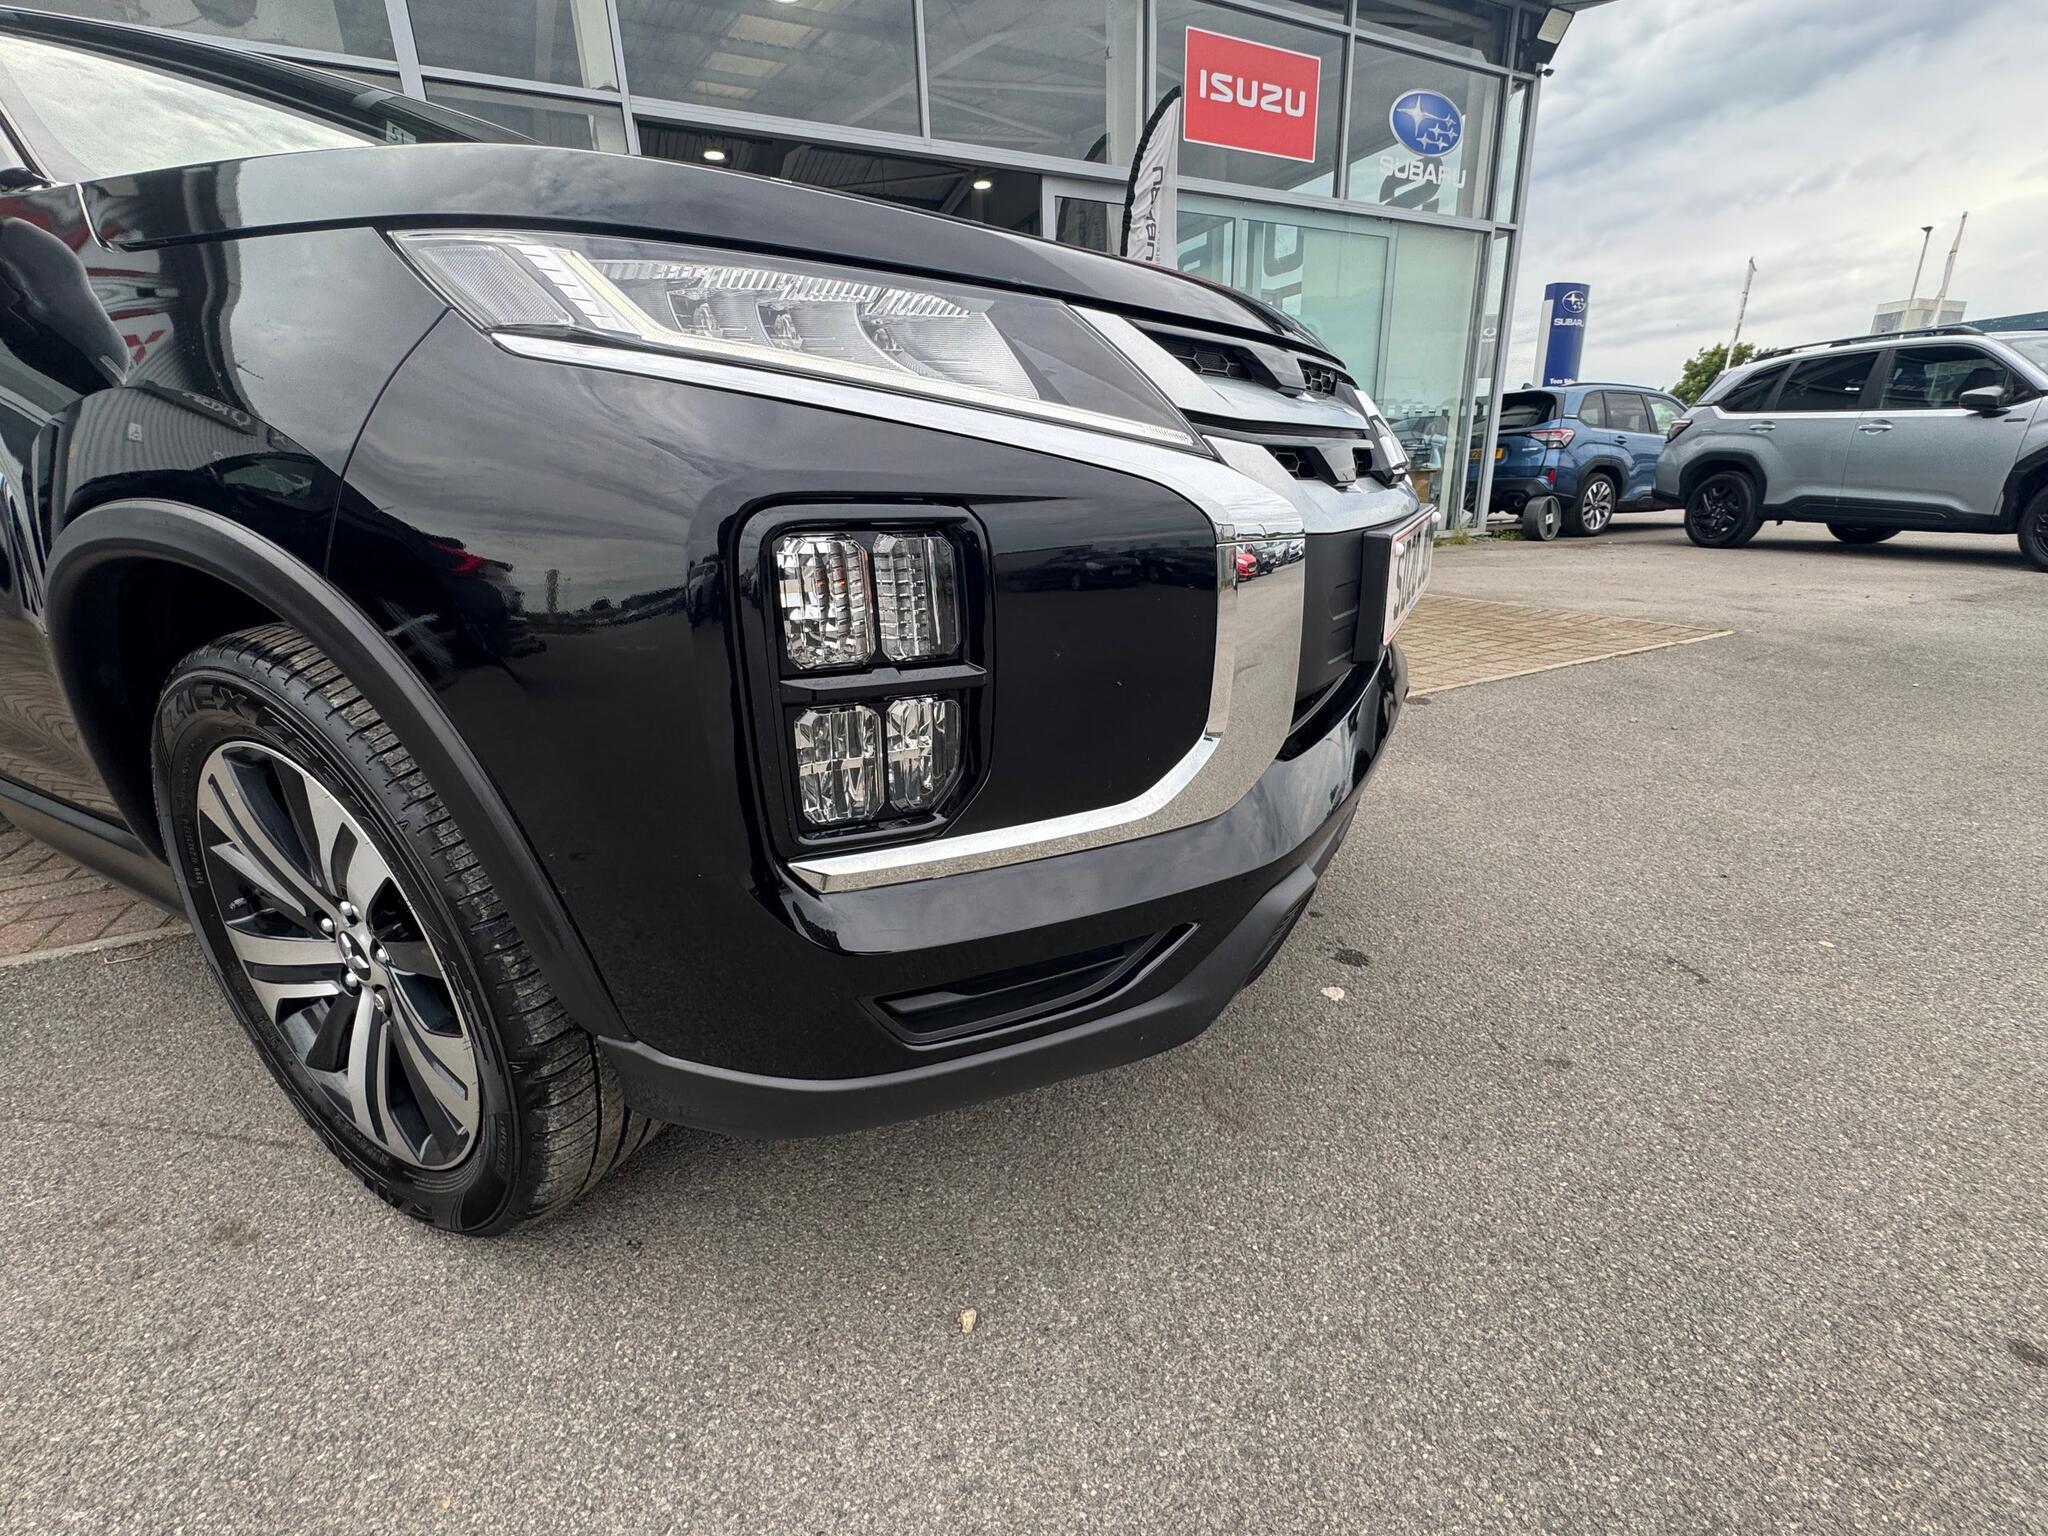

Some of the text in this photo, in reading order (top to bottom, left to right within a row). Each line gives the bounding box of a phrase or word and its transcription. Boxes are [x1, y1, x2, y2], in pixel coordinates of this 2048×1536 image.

[1199, 69, 1306, 118] ISUZU
[1379, 155, 1466, 189] SUBARU
[1145, 166, 1163, 262] UBARU
[1553, 318, 1585, 328] SUBAR
